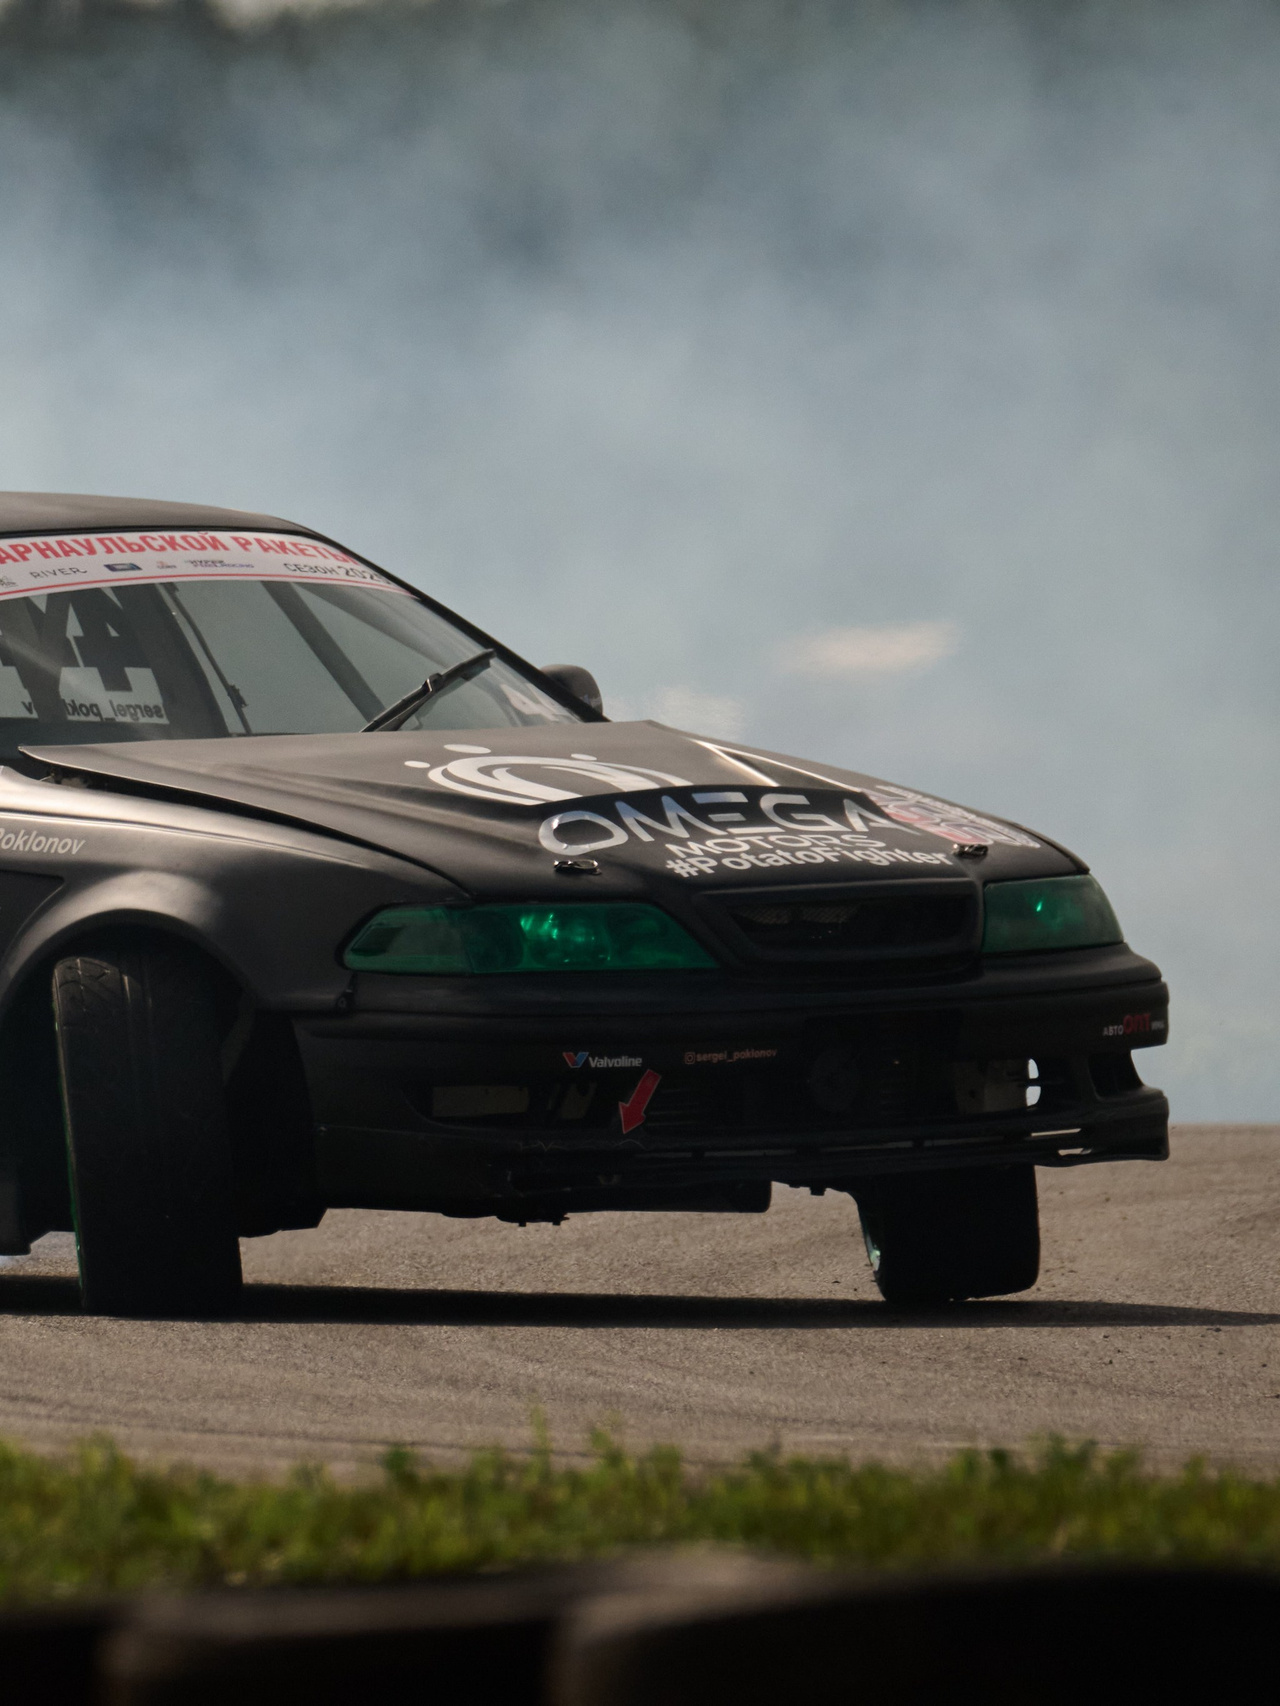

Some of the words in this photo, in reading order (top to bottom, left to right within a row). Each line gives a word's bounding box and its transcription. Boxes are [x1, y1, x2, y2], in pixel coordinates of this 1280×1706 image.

[29, 567, 88, 580] RIVER
[283, 562, 338, 576] СЕЗОН
[538, 791, 922, 857] OMEGA
[665, 834, 886, 859] MOTORS
[665, 846, 953, 878] #PotatoFighter
[588, 1055, 643, 1069] Valvoline
